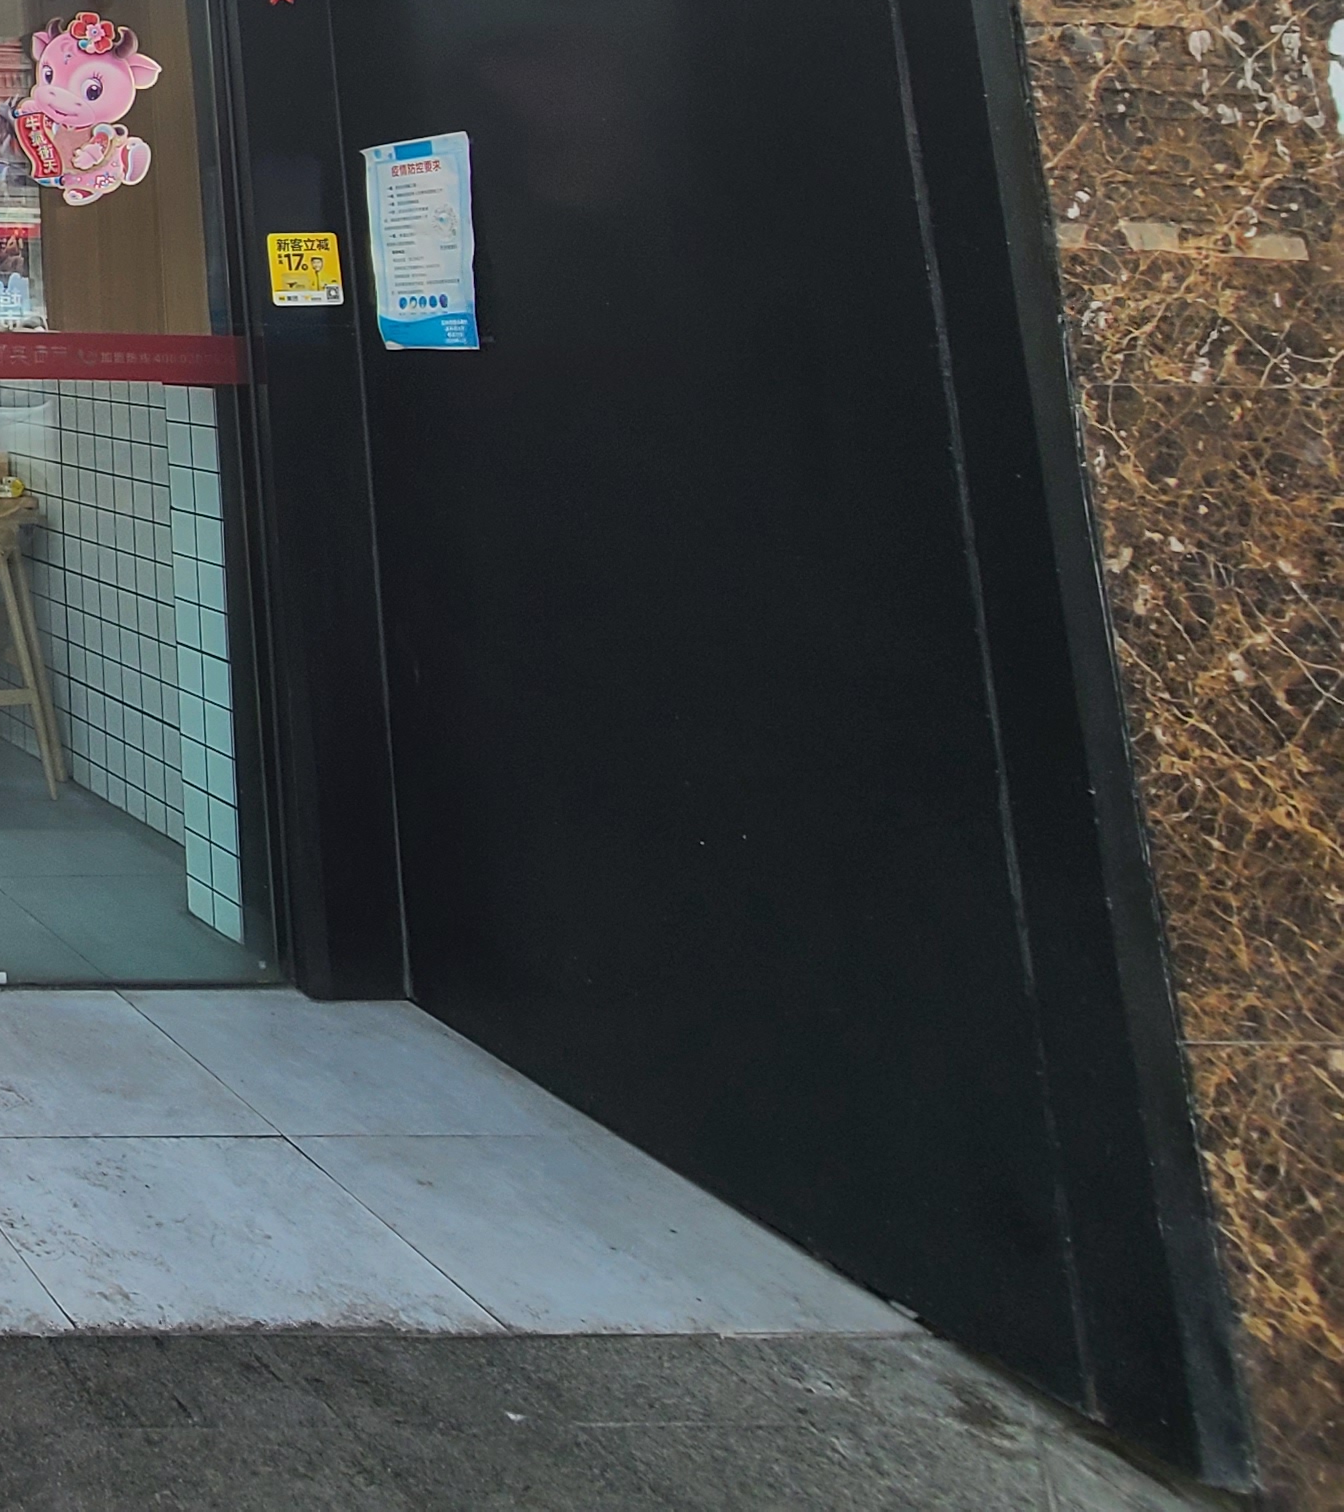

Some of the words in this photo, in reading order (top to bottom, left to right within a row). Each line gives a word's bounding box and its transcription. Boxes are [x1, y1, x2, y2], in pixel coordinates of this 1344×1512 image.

[391, 159, 442, 178] 疫情防控要求
[276, 238, 330, 252] 新客立减
